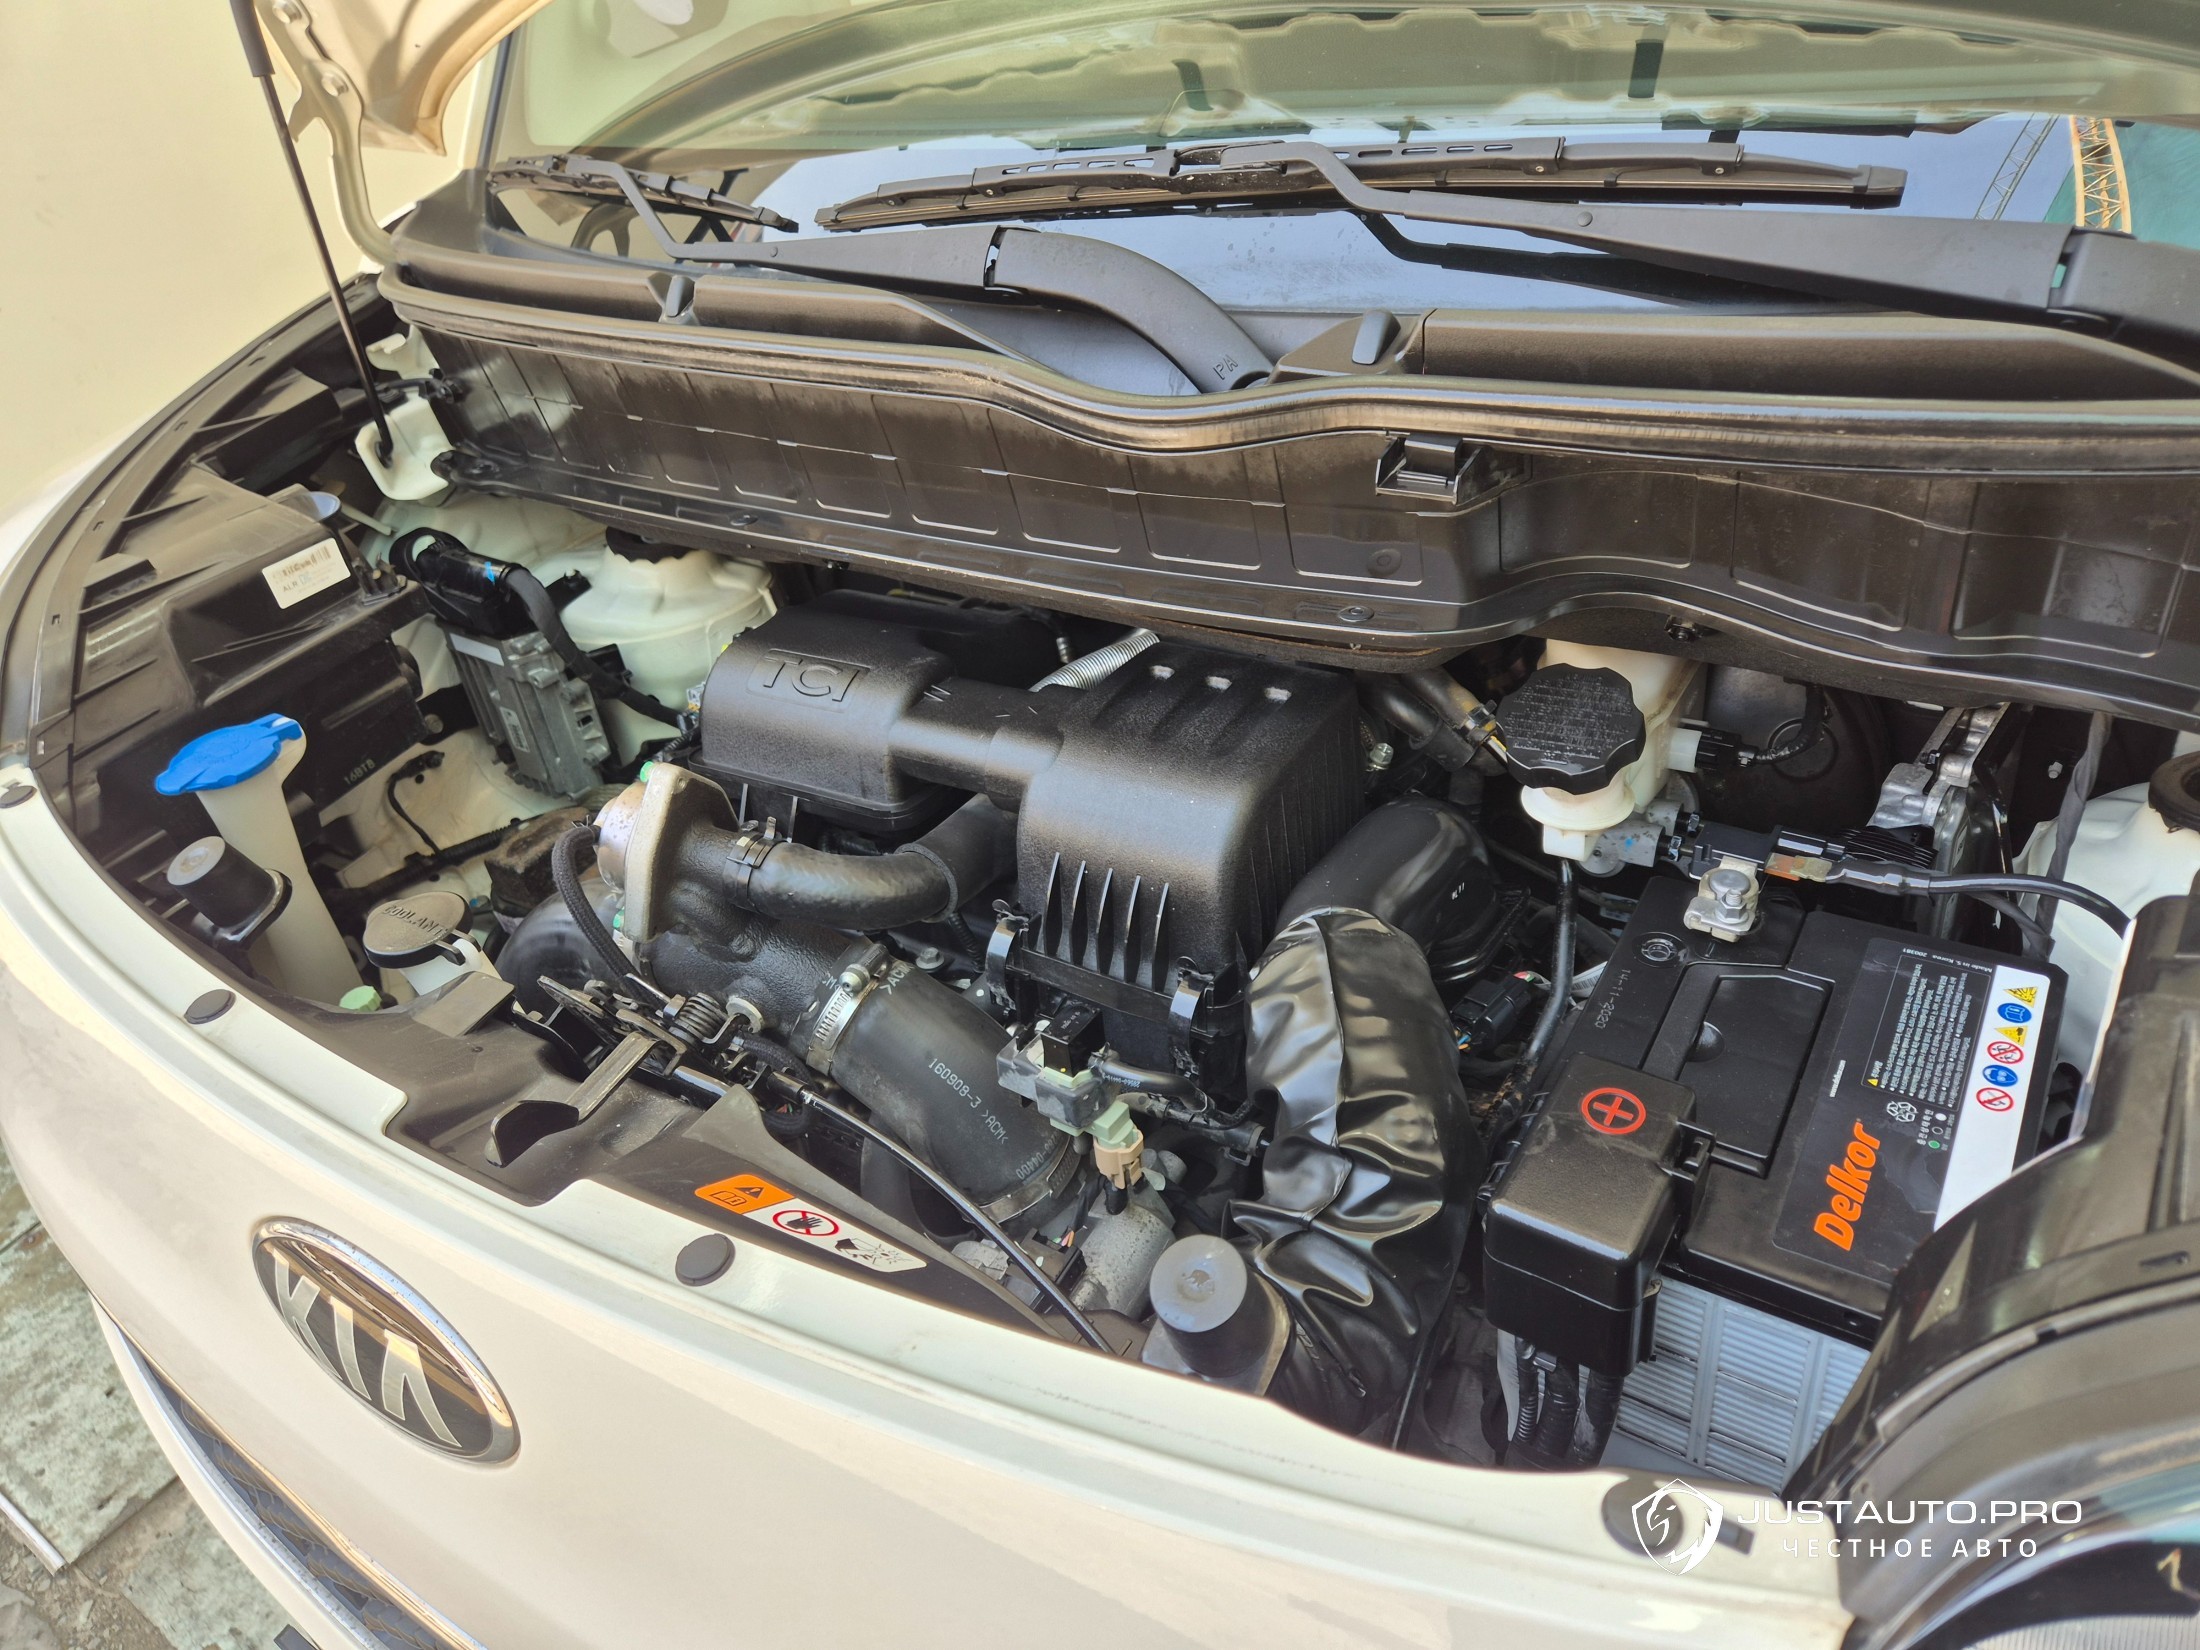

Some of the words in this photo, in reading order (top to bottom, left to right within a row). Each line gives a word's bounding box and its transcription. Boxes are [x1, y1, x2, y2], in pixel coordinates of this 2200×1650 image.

[1212, 353, 1239, 381] PA
[762, 655, 861, 703] TCI
[382, 905, 449, 937] COOLANT
[927, 1057, 983, 1110] 160908-3
[1813, 1121, 1881, 1252] Delkor
[272, 1248, 463, 1449] KIA
